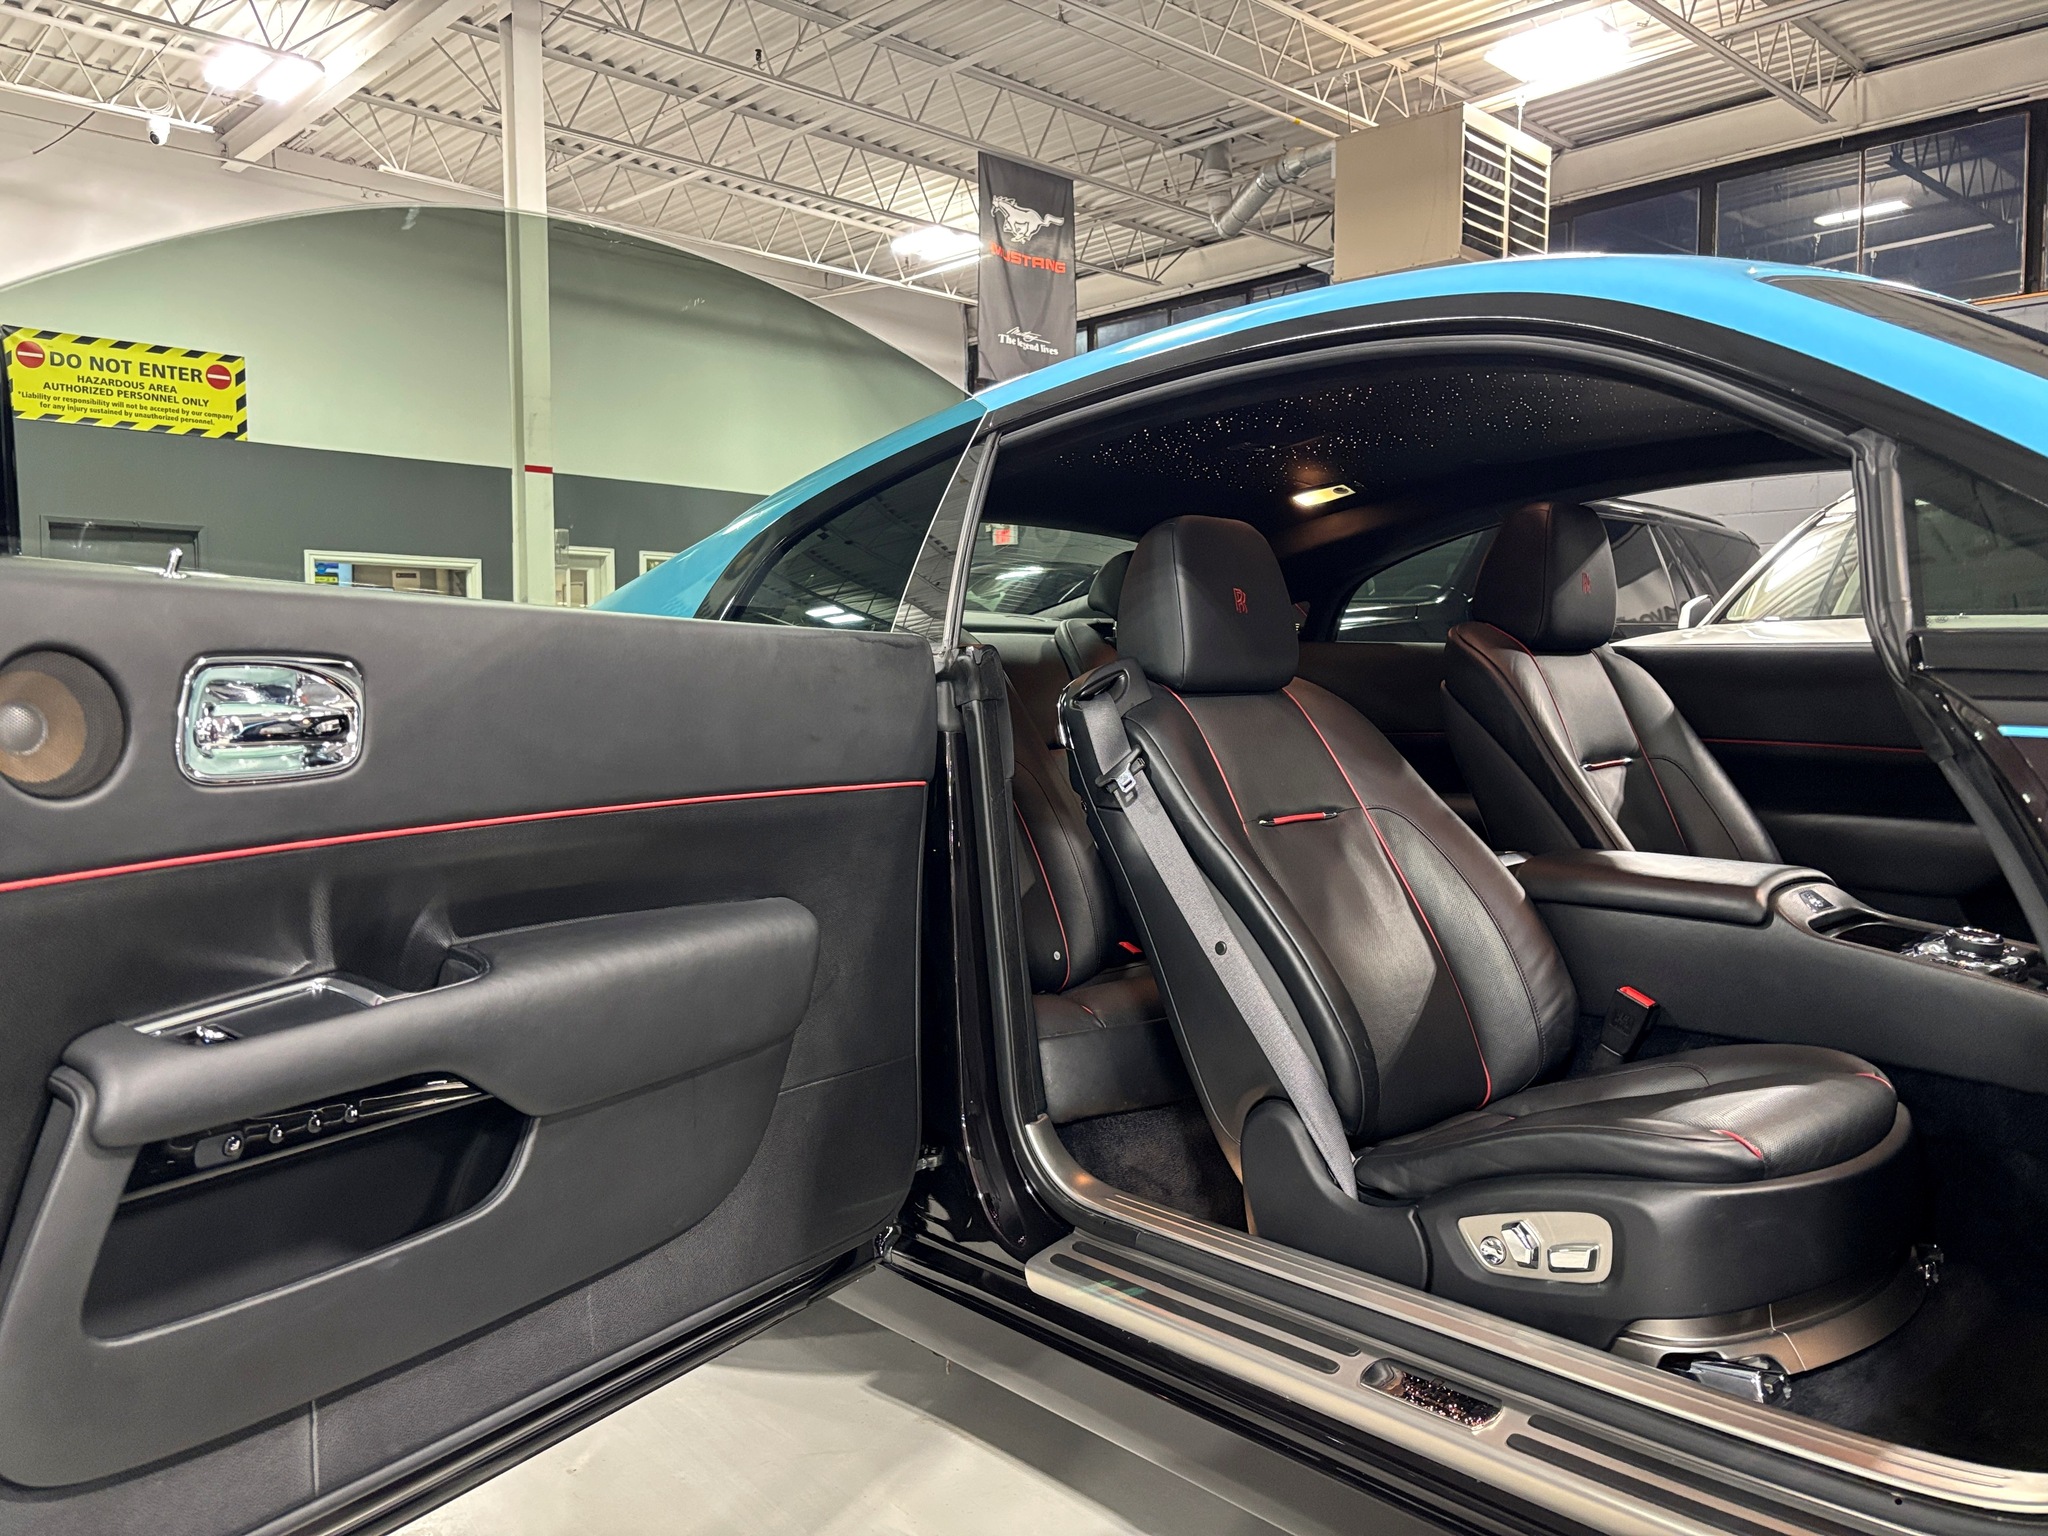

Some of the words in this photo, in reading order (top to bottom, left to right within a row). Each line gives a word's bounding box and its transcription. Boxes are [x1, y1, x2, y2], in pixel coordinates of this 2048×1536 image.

[990, 240, 1066, 274] MUSTANG
[997, 333, 1017, 346] The
[1017, 337, 1040, 352] legend
[1040, 344, 1059, 356] lives
[49, 351, 82, 369] DO
[90, 356, 132, 375] NOT
[139, 362, 203, 383] ENTER
[43, 382, 114, 397] AUTHORIZED
[117, 390, 180, 404] PERSONNEL
[182, 397, 209, 408] ONLY
[77, 375, 145, 390] HAZARDOUS
[148, 383, 178, 394] AREA
[52, 404, 66, 412] any
[67, 405, 88, 414] injury
[89, 406, 123, 416] sustained
[124, 410, 133, 418] by
[134, 411, 179, 422] unauthorized
[180, 416, 215, 426] personnel.
[62, 396, 110, 407] responsibility
[139, 403, 148, 411] be
[149, 406, 180, 415] accepted
[181, 409, 190, 417] by
[204, 411, 234, 421] company
